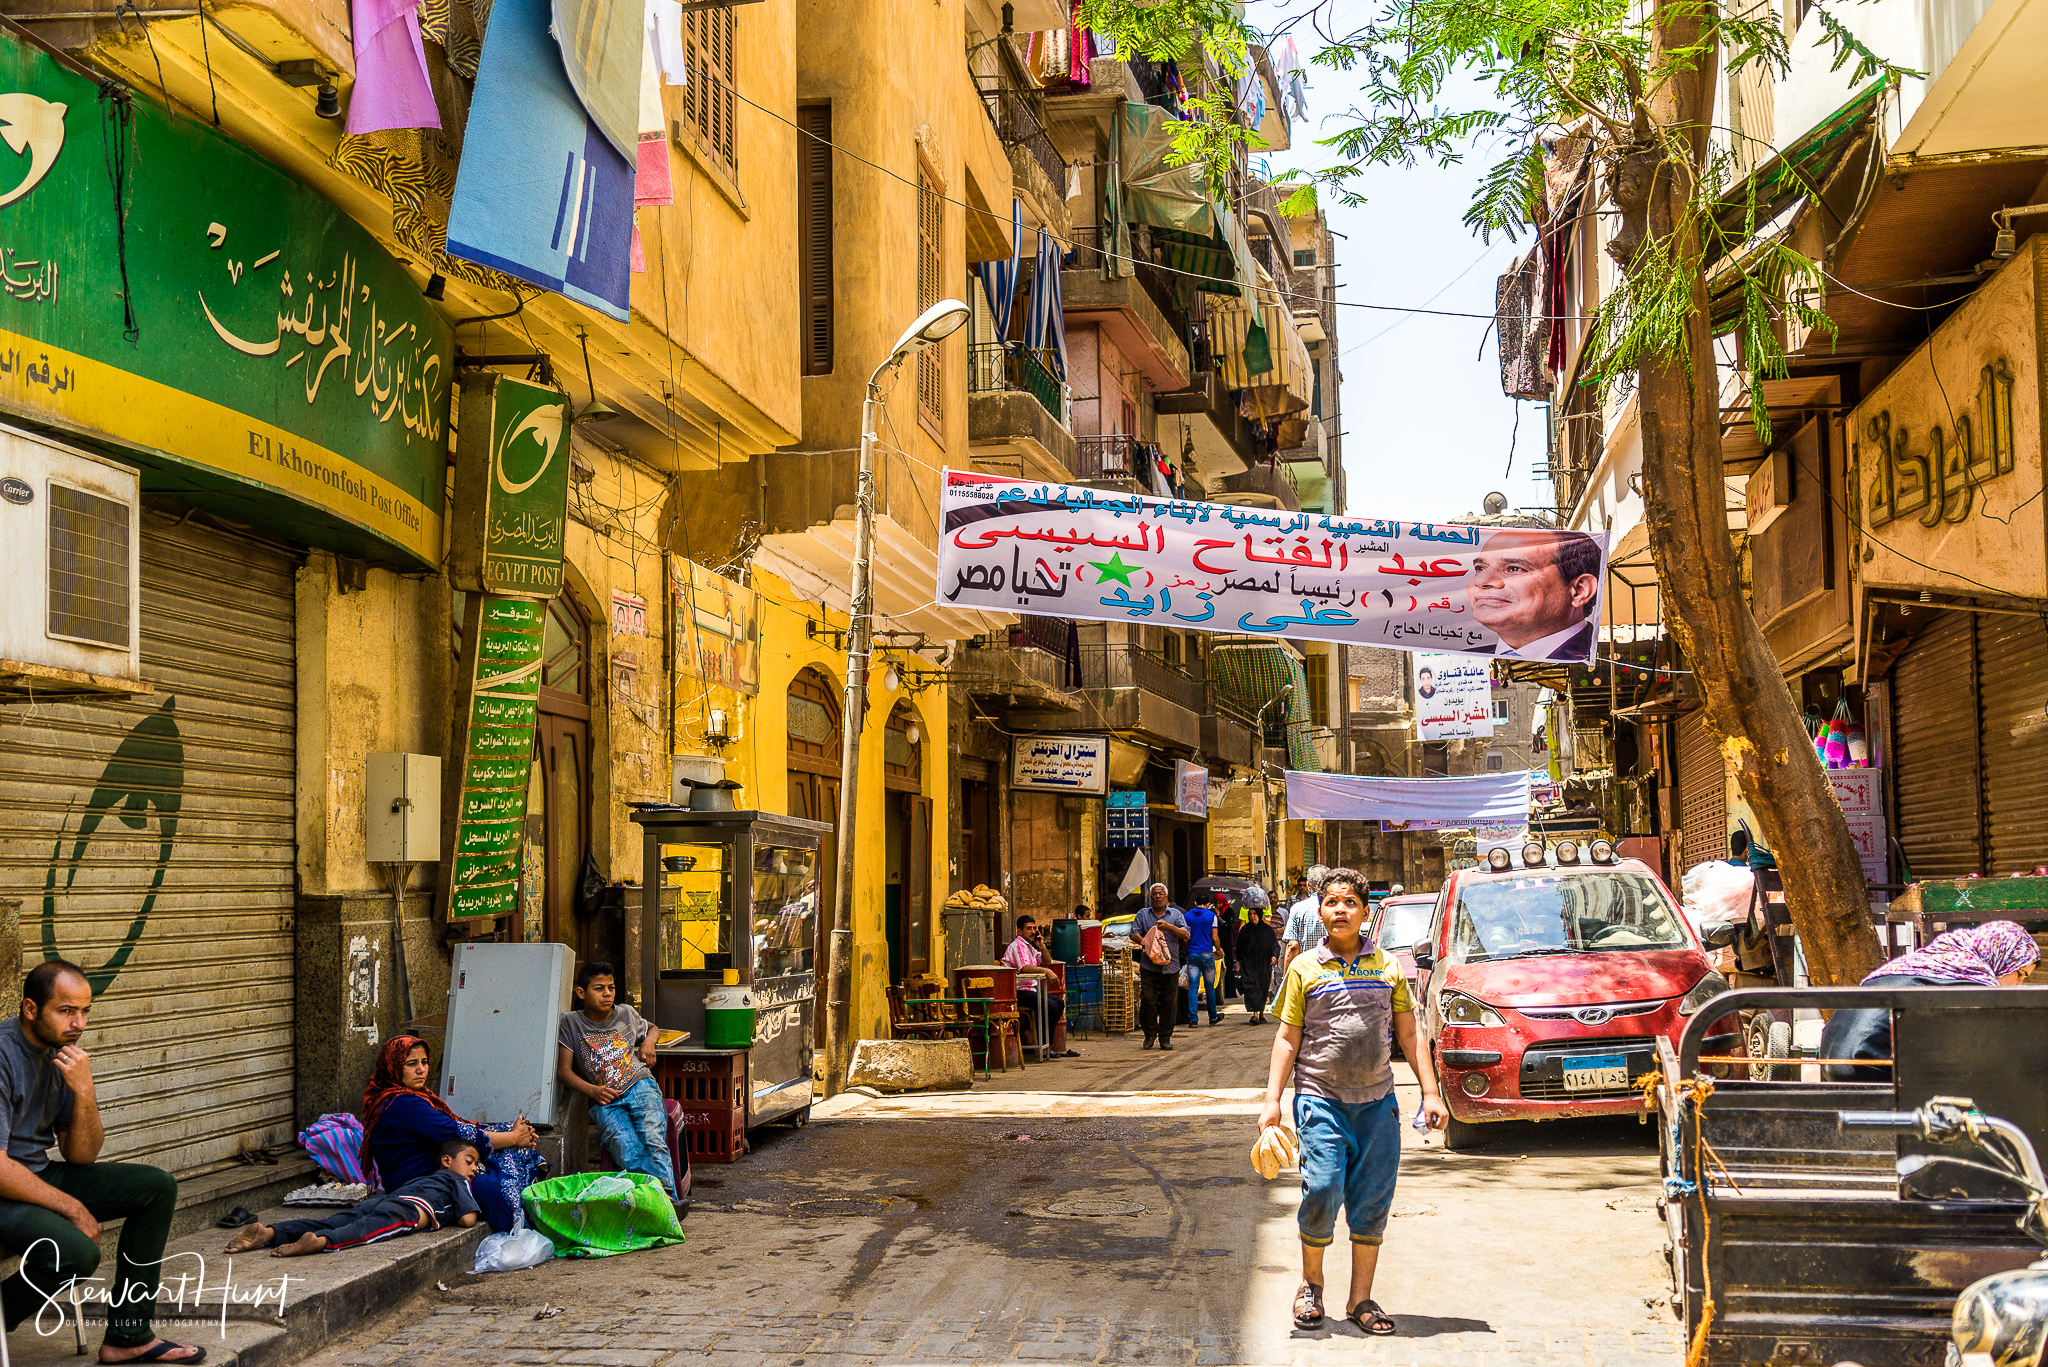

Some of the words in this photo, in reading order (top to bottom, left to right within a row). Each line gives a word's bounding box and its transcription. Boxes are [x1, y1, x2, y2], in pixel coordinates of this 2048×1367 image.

[355, 297, 405, 423] بريد
[26, 353, 75, 395] الرقم
[402, 337, 442, 446] مكتب
[3, 482, 30, 498] Carrier
[247, 430, 272, 462] El
[278, 442, 367, 503] khoronfosh
[370, 485, 392, 516] Post
[394, 499, 420, 532] Office
[949, 490, 994, 500] 01155588028
[996, 485, 1048, 509] لدعم
[1056, 486, 1143, 518] الجمالية
[1221, 506, 1309, 534] الرسمية
[1318, 515, 1400, 539] الشعبية
[525, 515, 562, 550] البريد
[1409, 522, 1480, 545] الحملة
[1193, 533, 1348, 575] الفتاح
[1354, 541, 1389, 553] المشير
[487, 561, 528, 583] EGYPT
[530, 565, 560, 586] POST
[1011, 544, 1070, 605] تحيا
[1378, 552, 1469, 586] عبد
[944, 562, 1005, 601] مصر
[1165, 574, 1211, 591] رمز
[1211, 570, 1280, 595] لمصر
[1100, 586, 1215, 622] زايد
[1428, 597, 1465, 613] رقم
[489, 607, 533, 621] التوفير
[1393, 622, 1424, 639] الحاج
[1429, 625, 1462, 640] تحيات
[1467, 631, 1482, 645] مع
[479, 701, 505, 717] السيارات
[505, 702, 524, 718] تراخيص
[1462, 705, 1489, 725] المشير
[476, 733, 507, 749] الفواتير
[1064, 744, 1097, 760] سنترال
[473, 765, 495, 781] حكومية
[468, 798, 497, 814] السريع
[497, 798, 514, 812] البريد
[464, 830, 491, 846] المسجل
[493, 830, 510, 845] البريد
